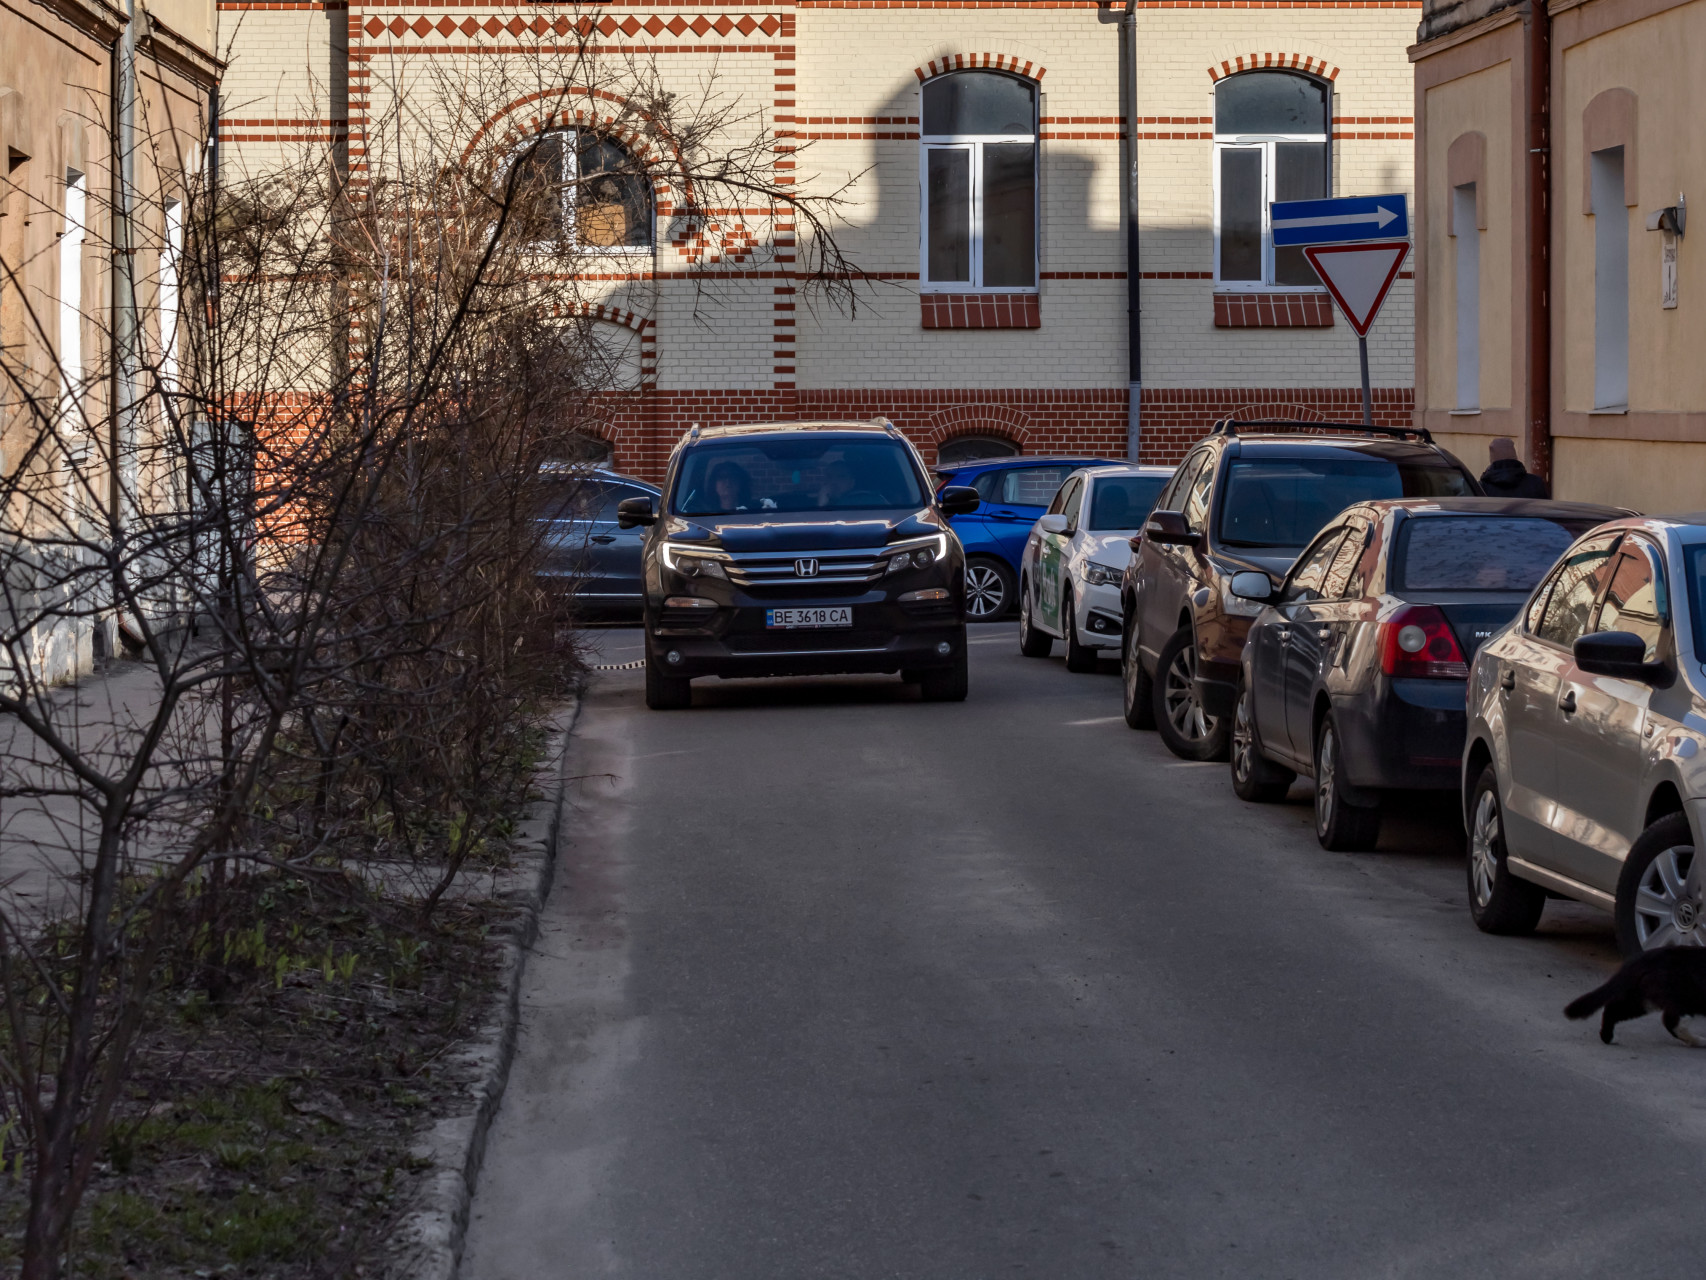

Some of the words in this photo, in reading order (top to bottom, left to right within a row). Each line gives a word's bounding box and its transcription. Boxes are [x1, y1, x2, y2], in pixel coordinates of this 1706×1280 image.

[774, 611, 793, 624] BE
[797, 609, 827, 624] 3618
[829, 609, 849, 623] CA
